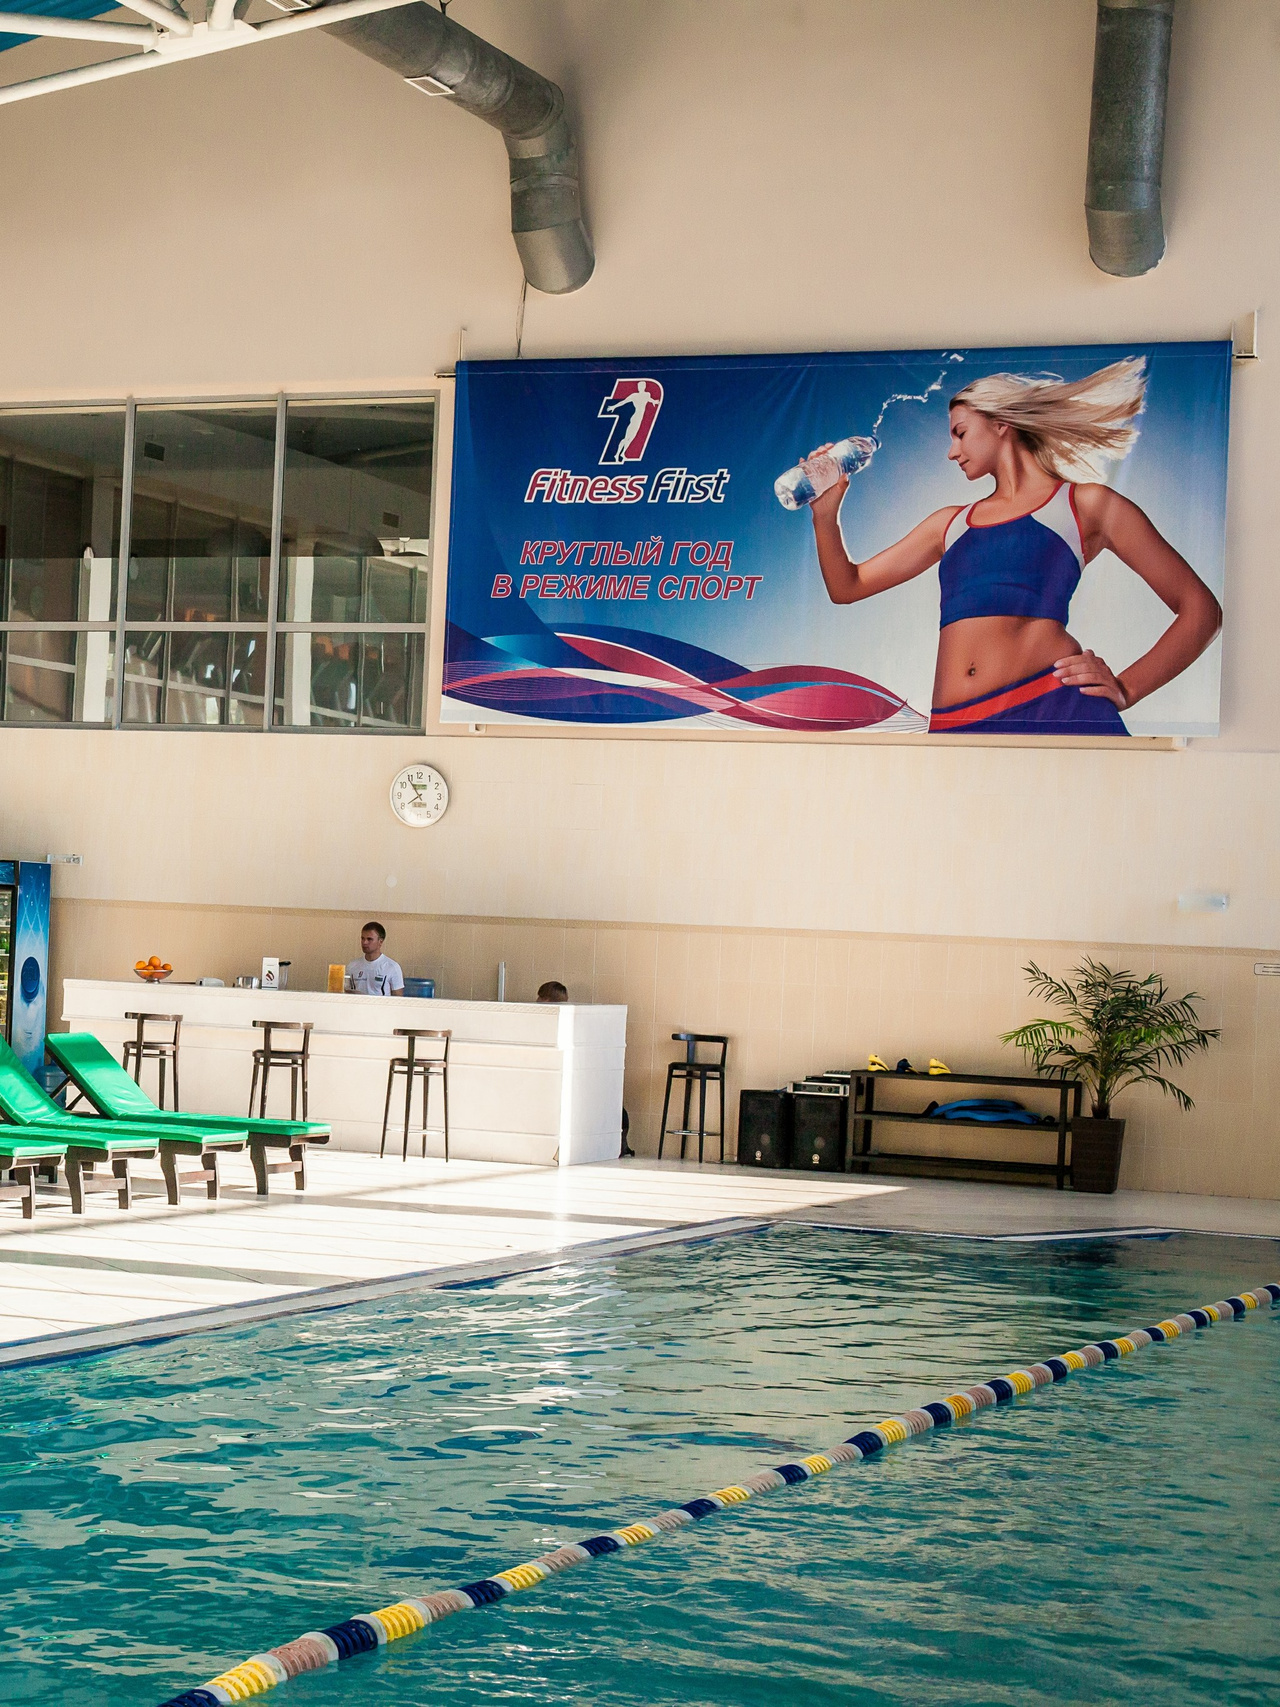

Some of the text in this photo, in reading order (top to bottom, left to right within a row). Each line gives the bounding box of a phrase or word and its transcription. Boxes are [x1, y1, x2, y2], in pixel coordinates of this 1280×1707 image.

[524, 467, 731, 503] Fitness First
[520, 535, 734, 571] КРУГЛЫЙ ГОД
[491, 574, 764, 600] В РЕЖИМЕ СПОРТ
[400, 781, 407, 789] 10
[434, 782, 439, 790] 2
[400, 802, 405, 810] 8
